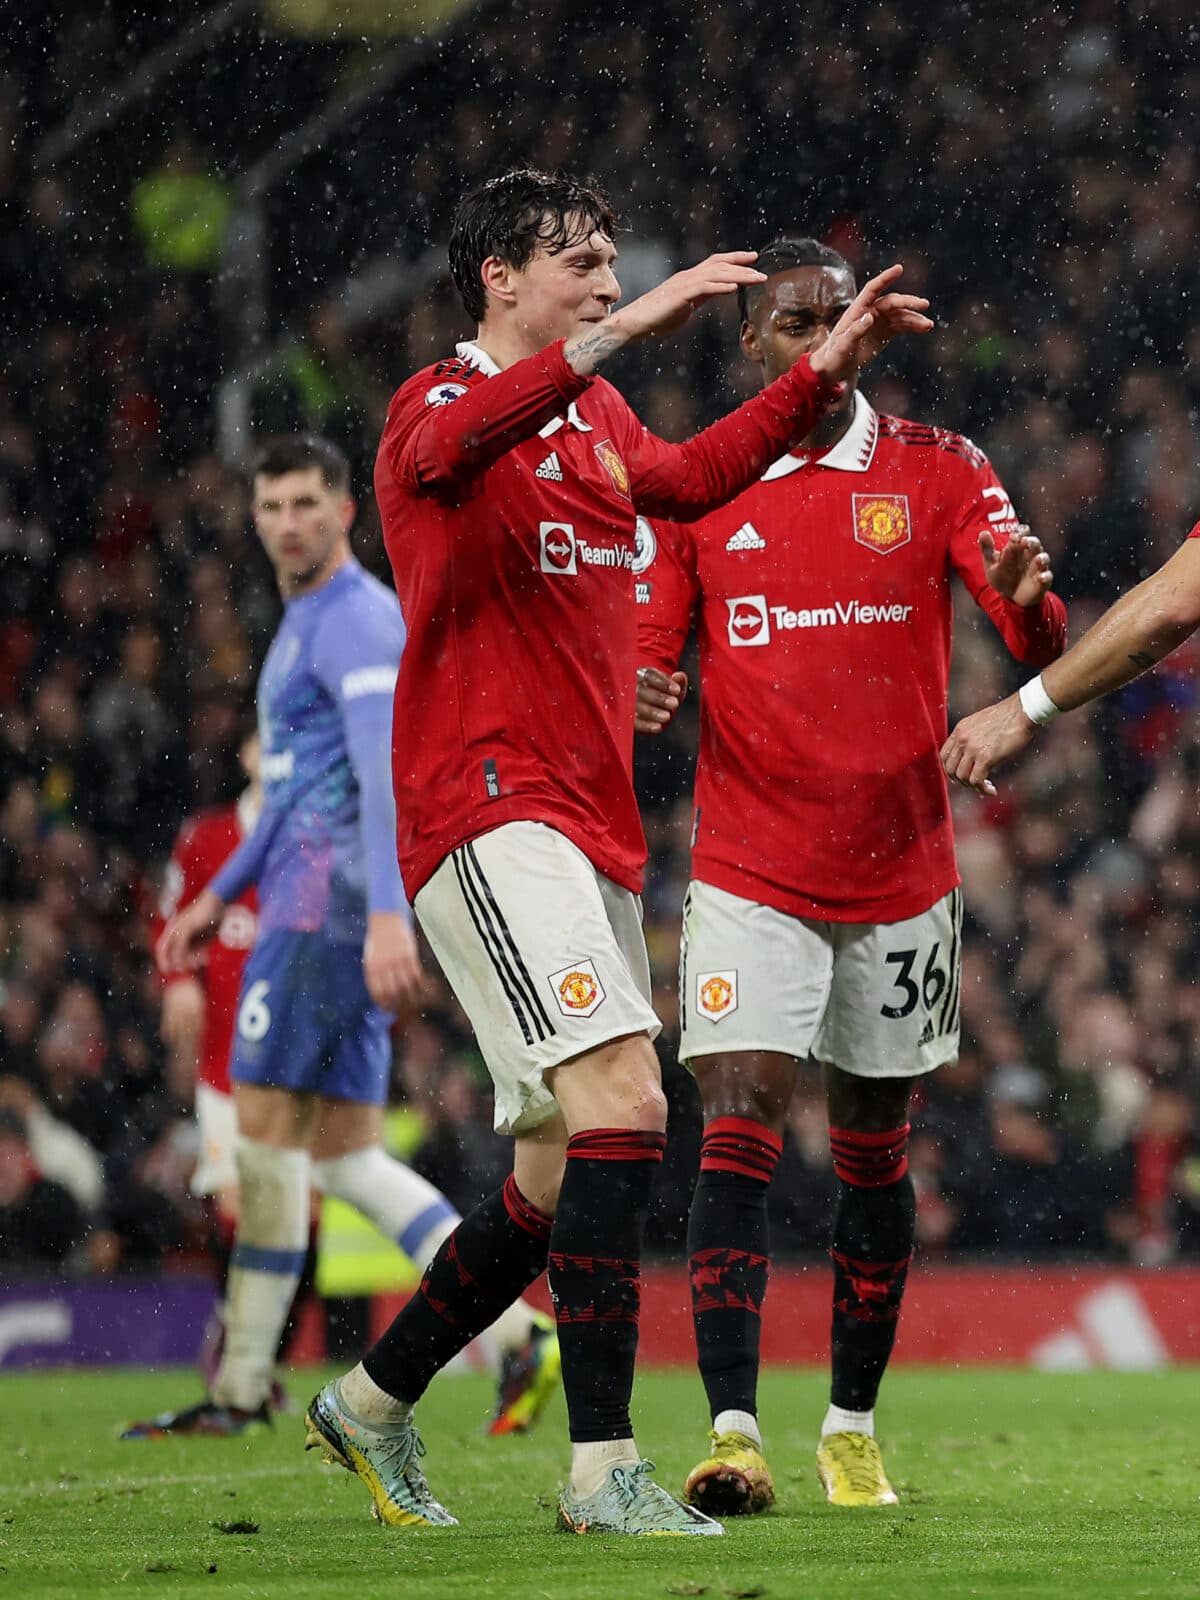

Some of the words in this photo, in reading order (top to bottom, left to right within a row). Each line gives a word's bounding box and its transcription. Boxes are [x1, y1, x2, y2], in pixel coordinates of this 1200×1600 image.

[535, 469, 563, 482] adidas
[726, 539, 766, 551] adidas
[770, 600, 912, 630] TeamViewer
[880, 942, 946, 1019] 36
[238, 980, 271, 1042] 6
